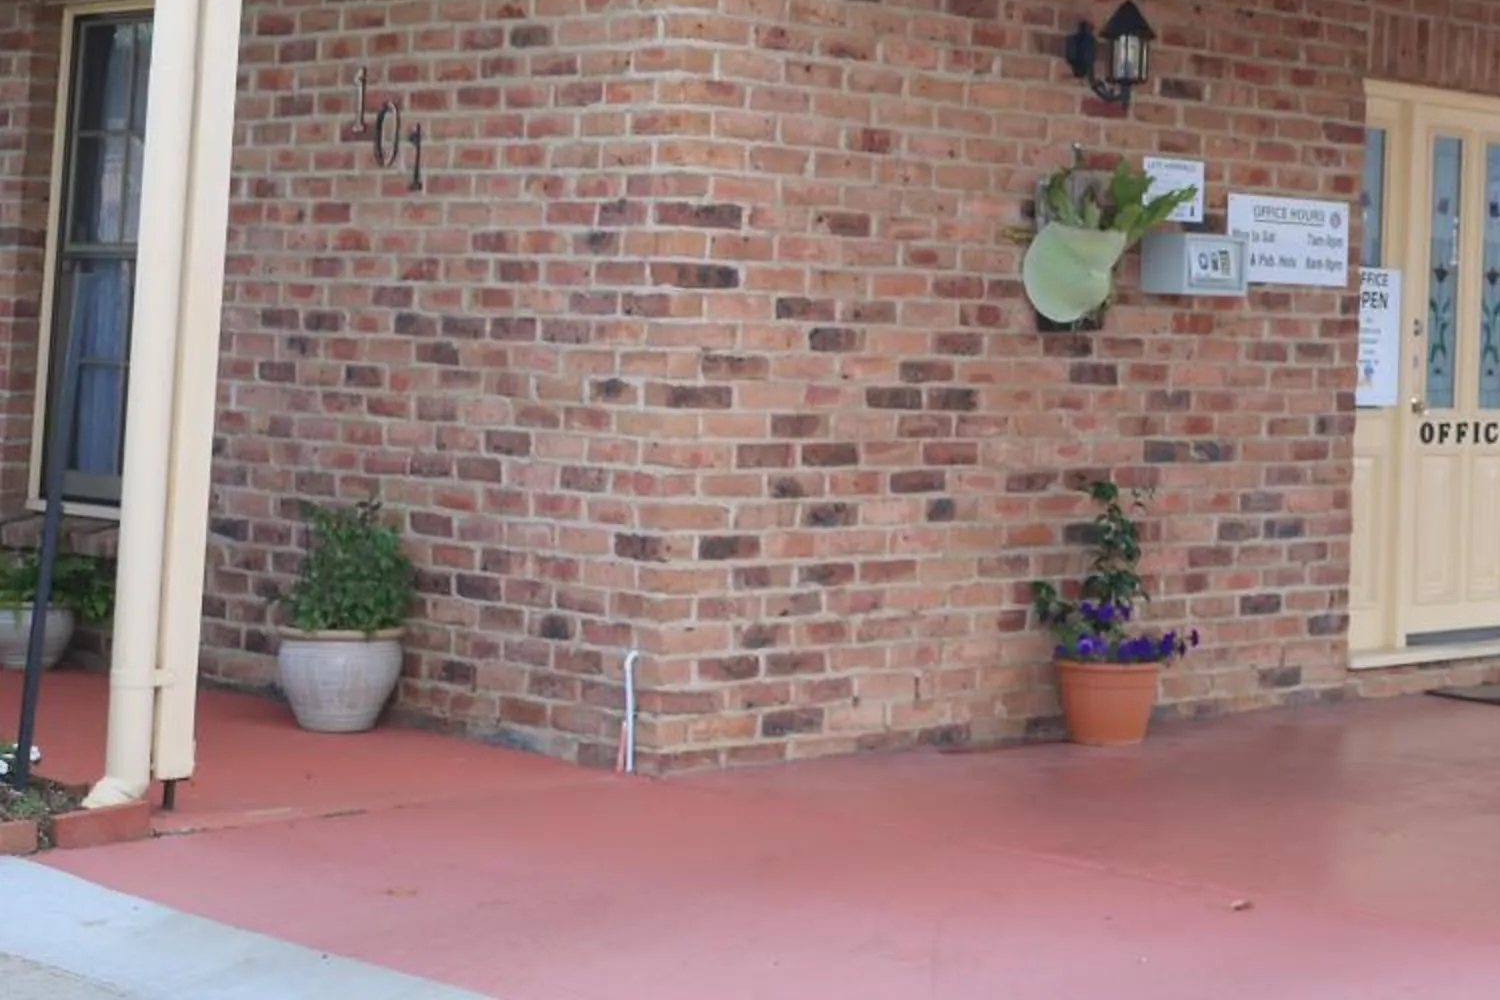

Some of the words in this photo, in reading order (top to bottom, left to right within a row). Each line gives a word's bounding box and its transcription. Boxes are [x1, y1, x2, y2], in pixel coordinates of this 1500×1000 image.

[1253, 205, 1287, 220] OFFICE
[1290, 207, 1325, 222] HOURS
[1361, 271, 1389, 287] FFICE
[1362, 291, 1389, 309] PEN
